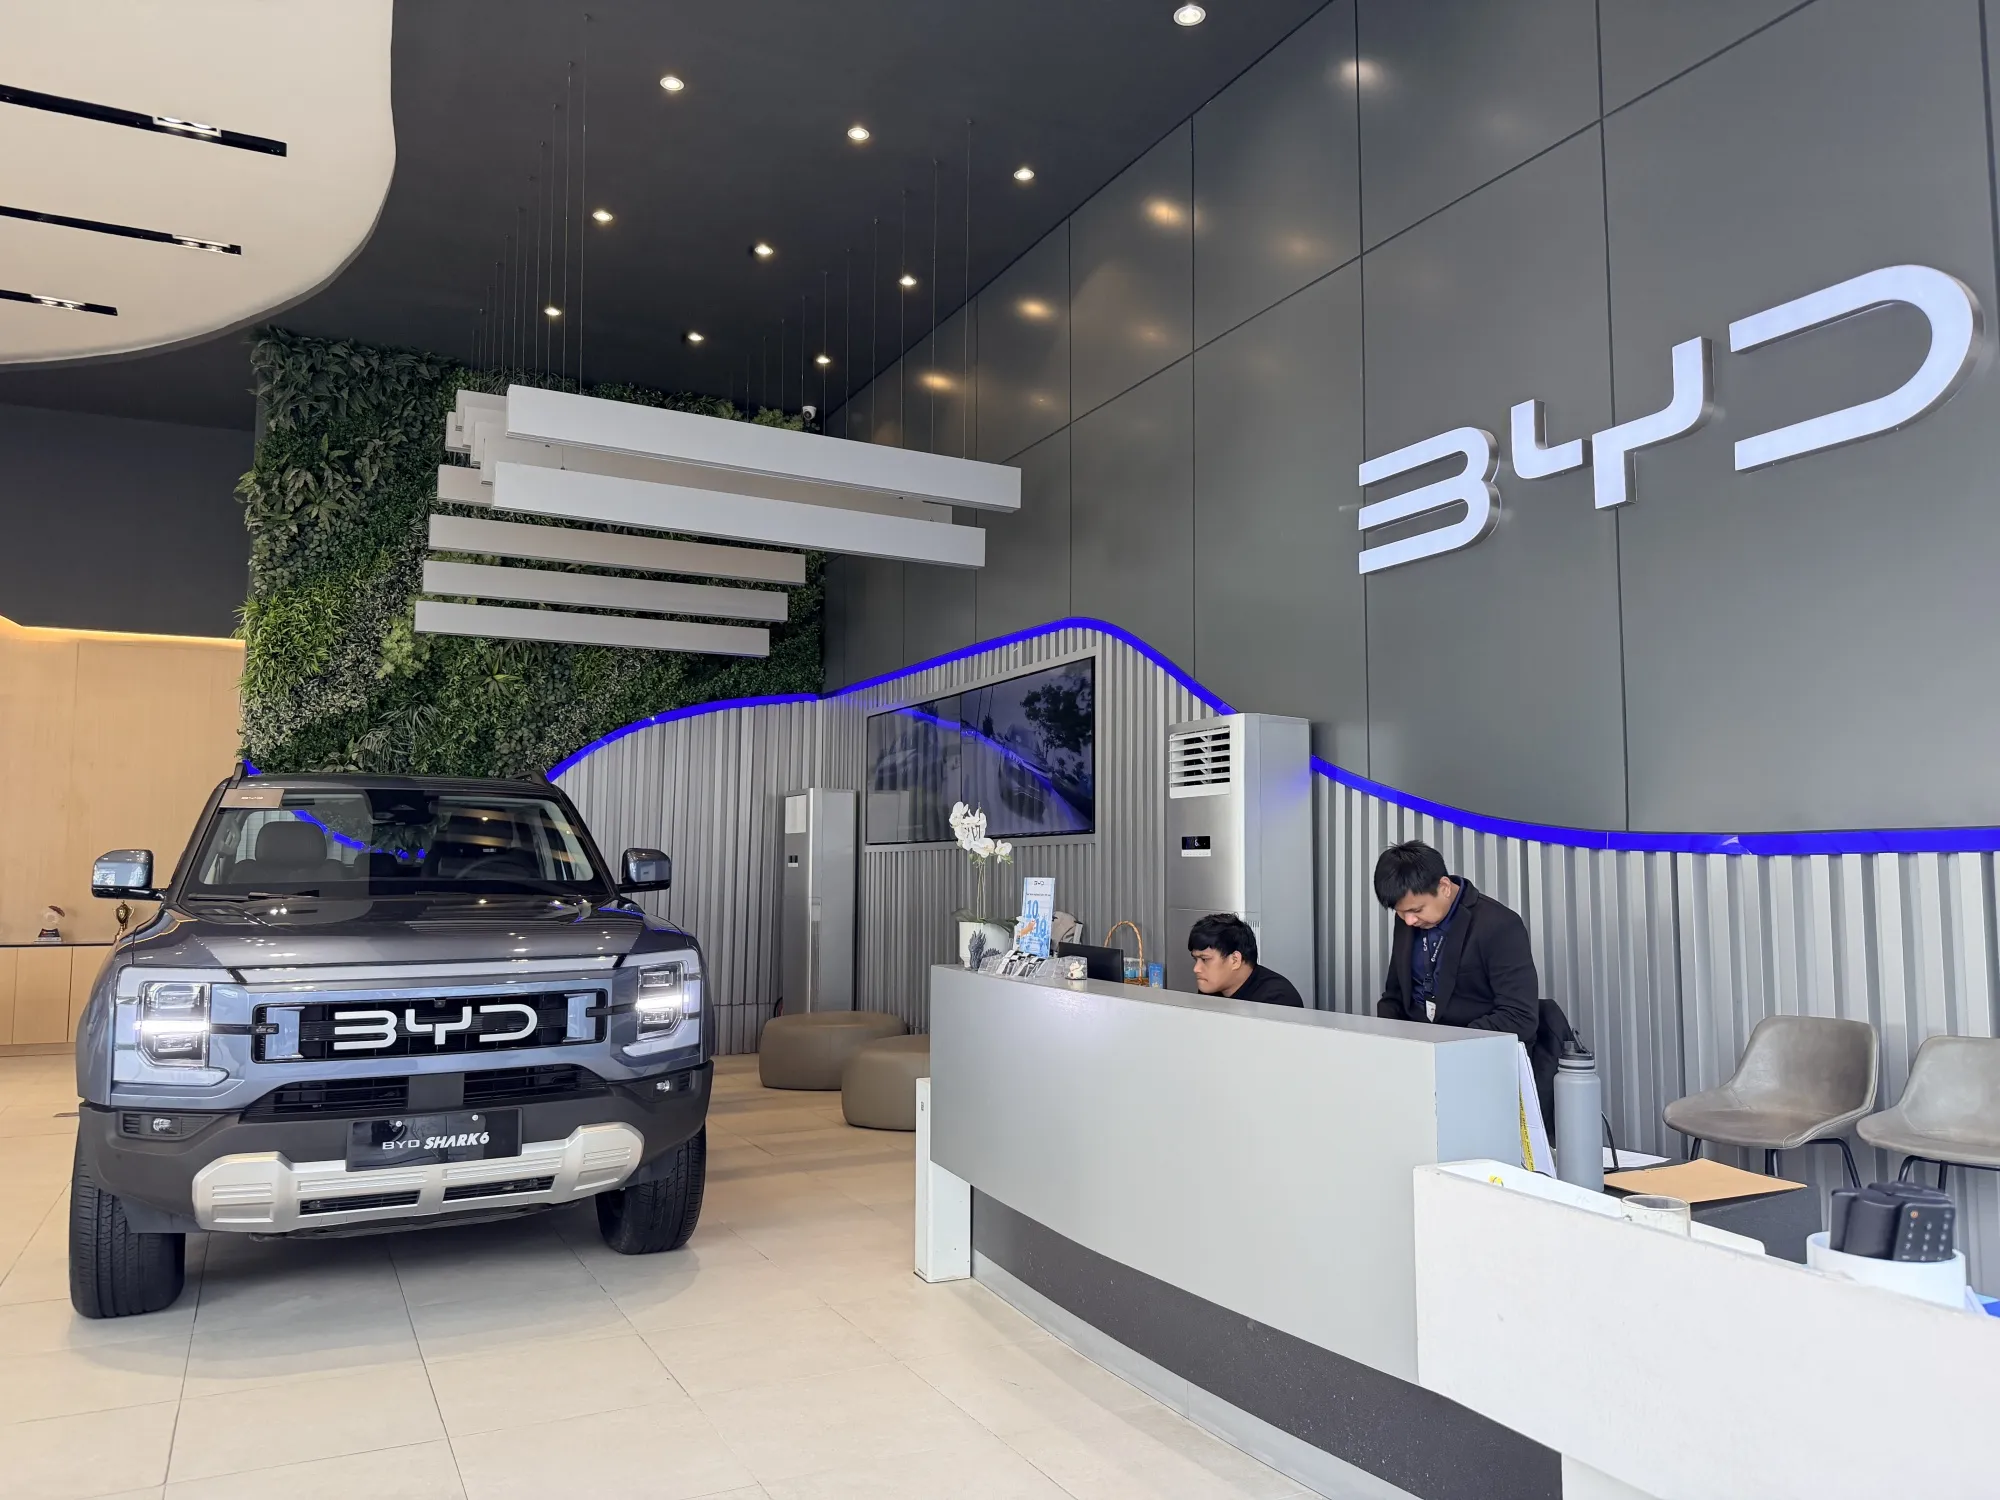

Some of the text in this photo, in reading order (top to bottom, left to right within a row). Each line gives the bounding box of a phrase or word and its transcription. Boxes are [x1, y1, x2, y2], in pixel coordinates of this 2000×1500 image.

[1359, 264, 1978, 575] BYD
[333, 1004, 538, 1050] BYD
[382, 1139, 420, 1150] BYD
